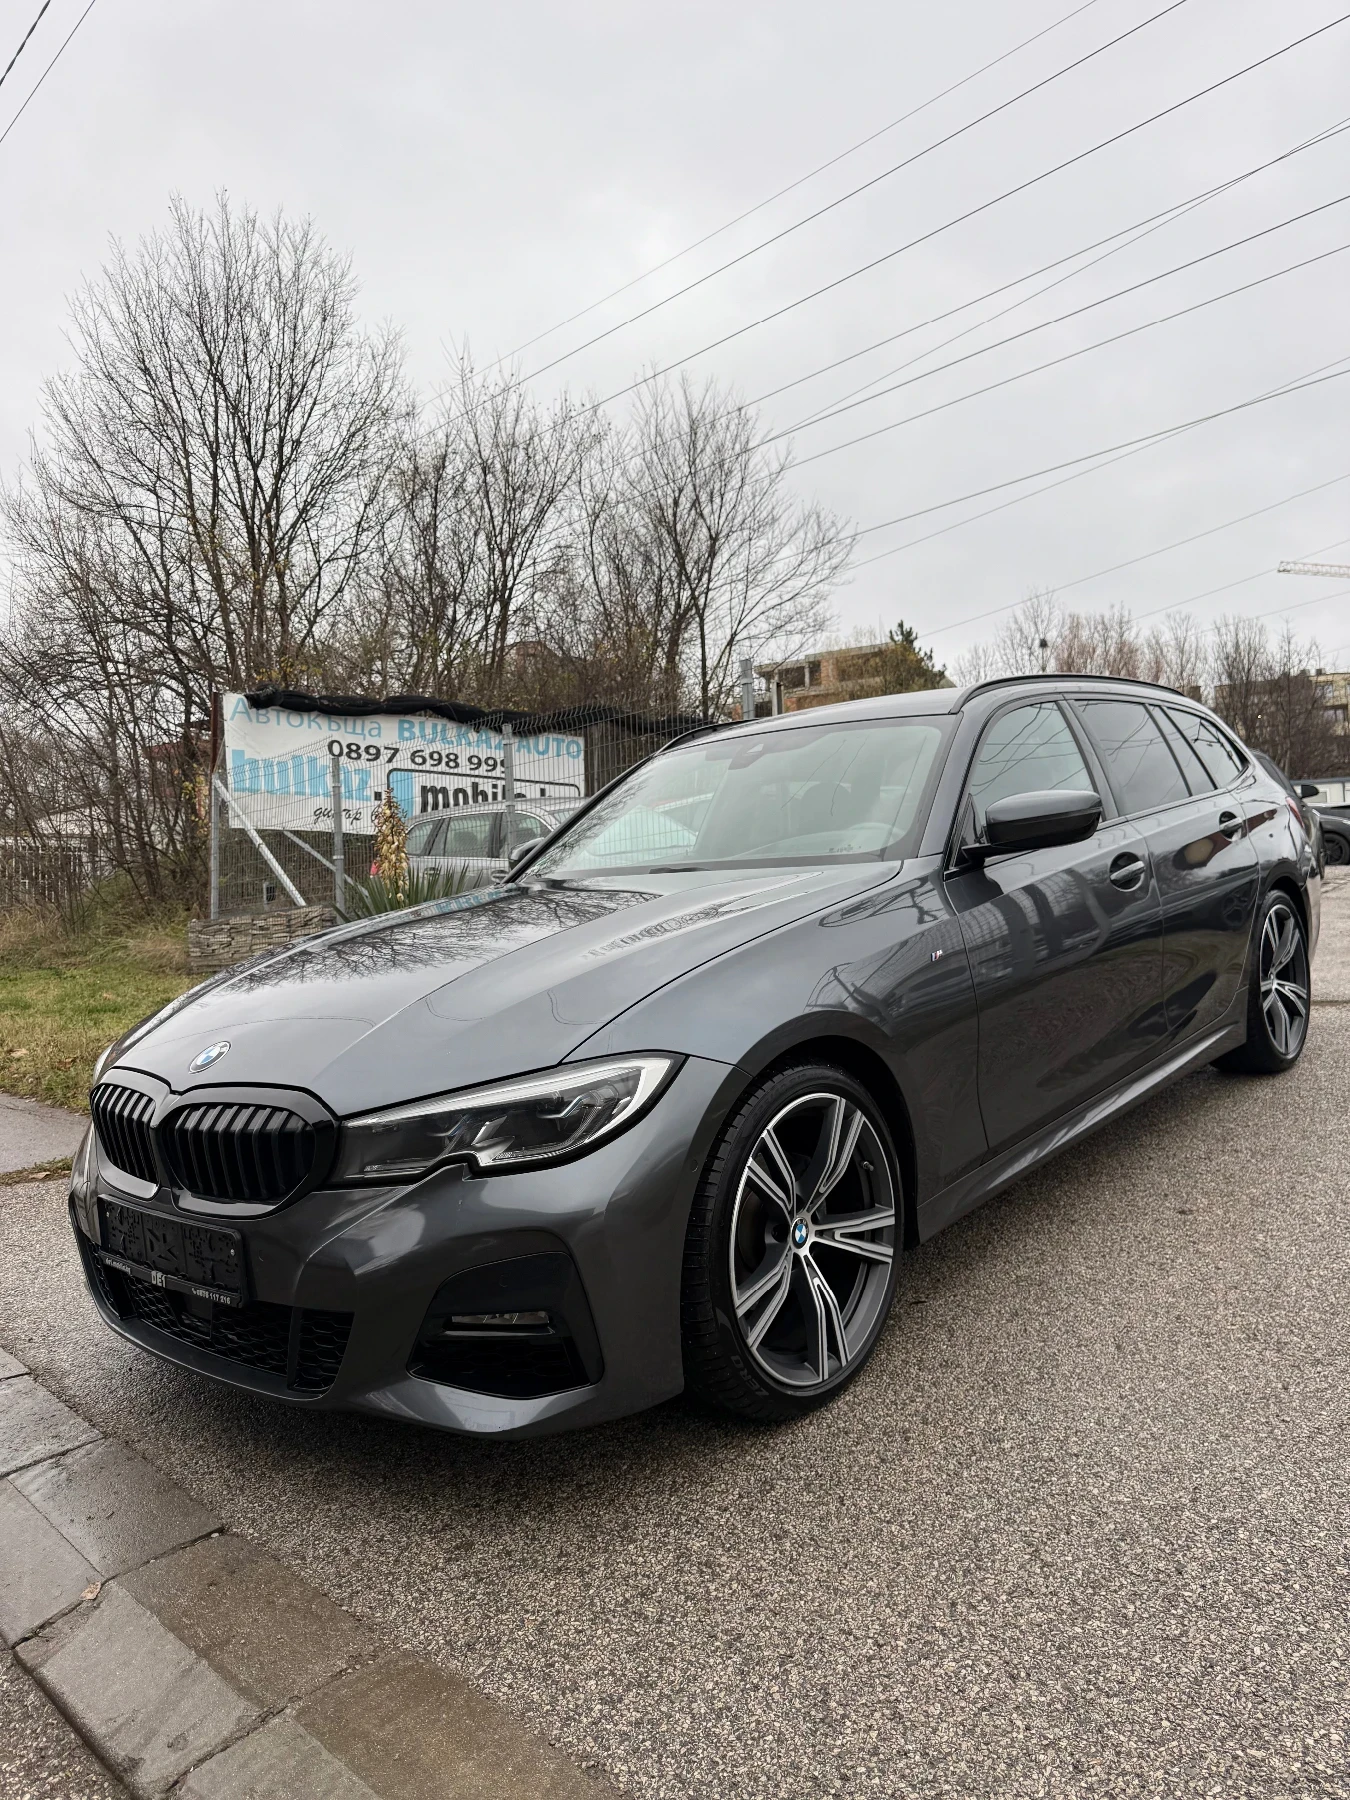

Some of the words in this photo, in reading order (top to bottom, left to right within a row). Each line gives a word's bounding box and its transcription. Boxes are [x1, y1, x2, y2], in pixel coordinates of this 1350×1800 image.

[229, 697, 382, 741] Автокъща
[515, 736, 582, 759] AUTO
[327, 739, 399, 764] 0897
[410, 749, 460, 769] 698
[730, 1355, 769, 1396] ZERO
